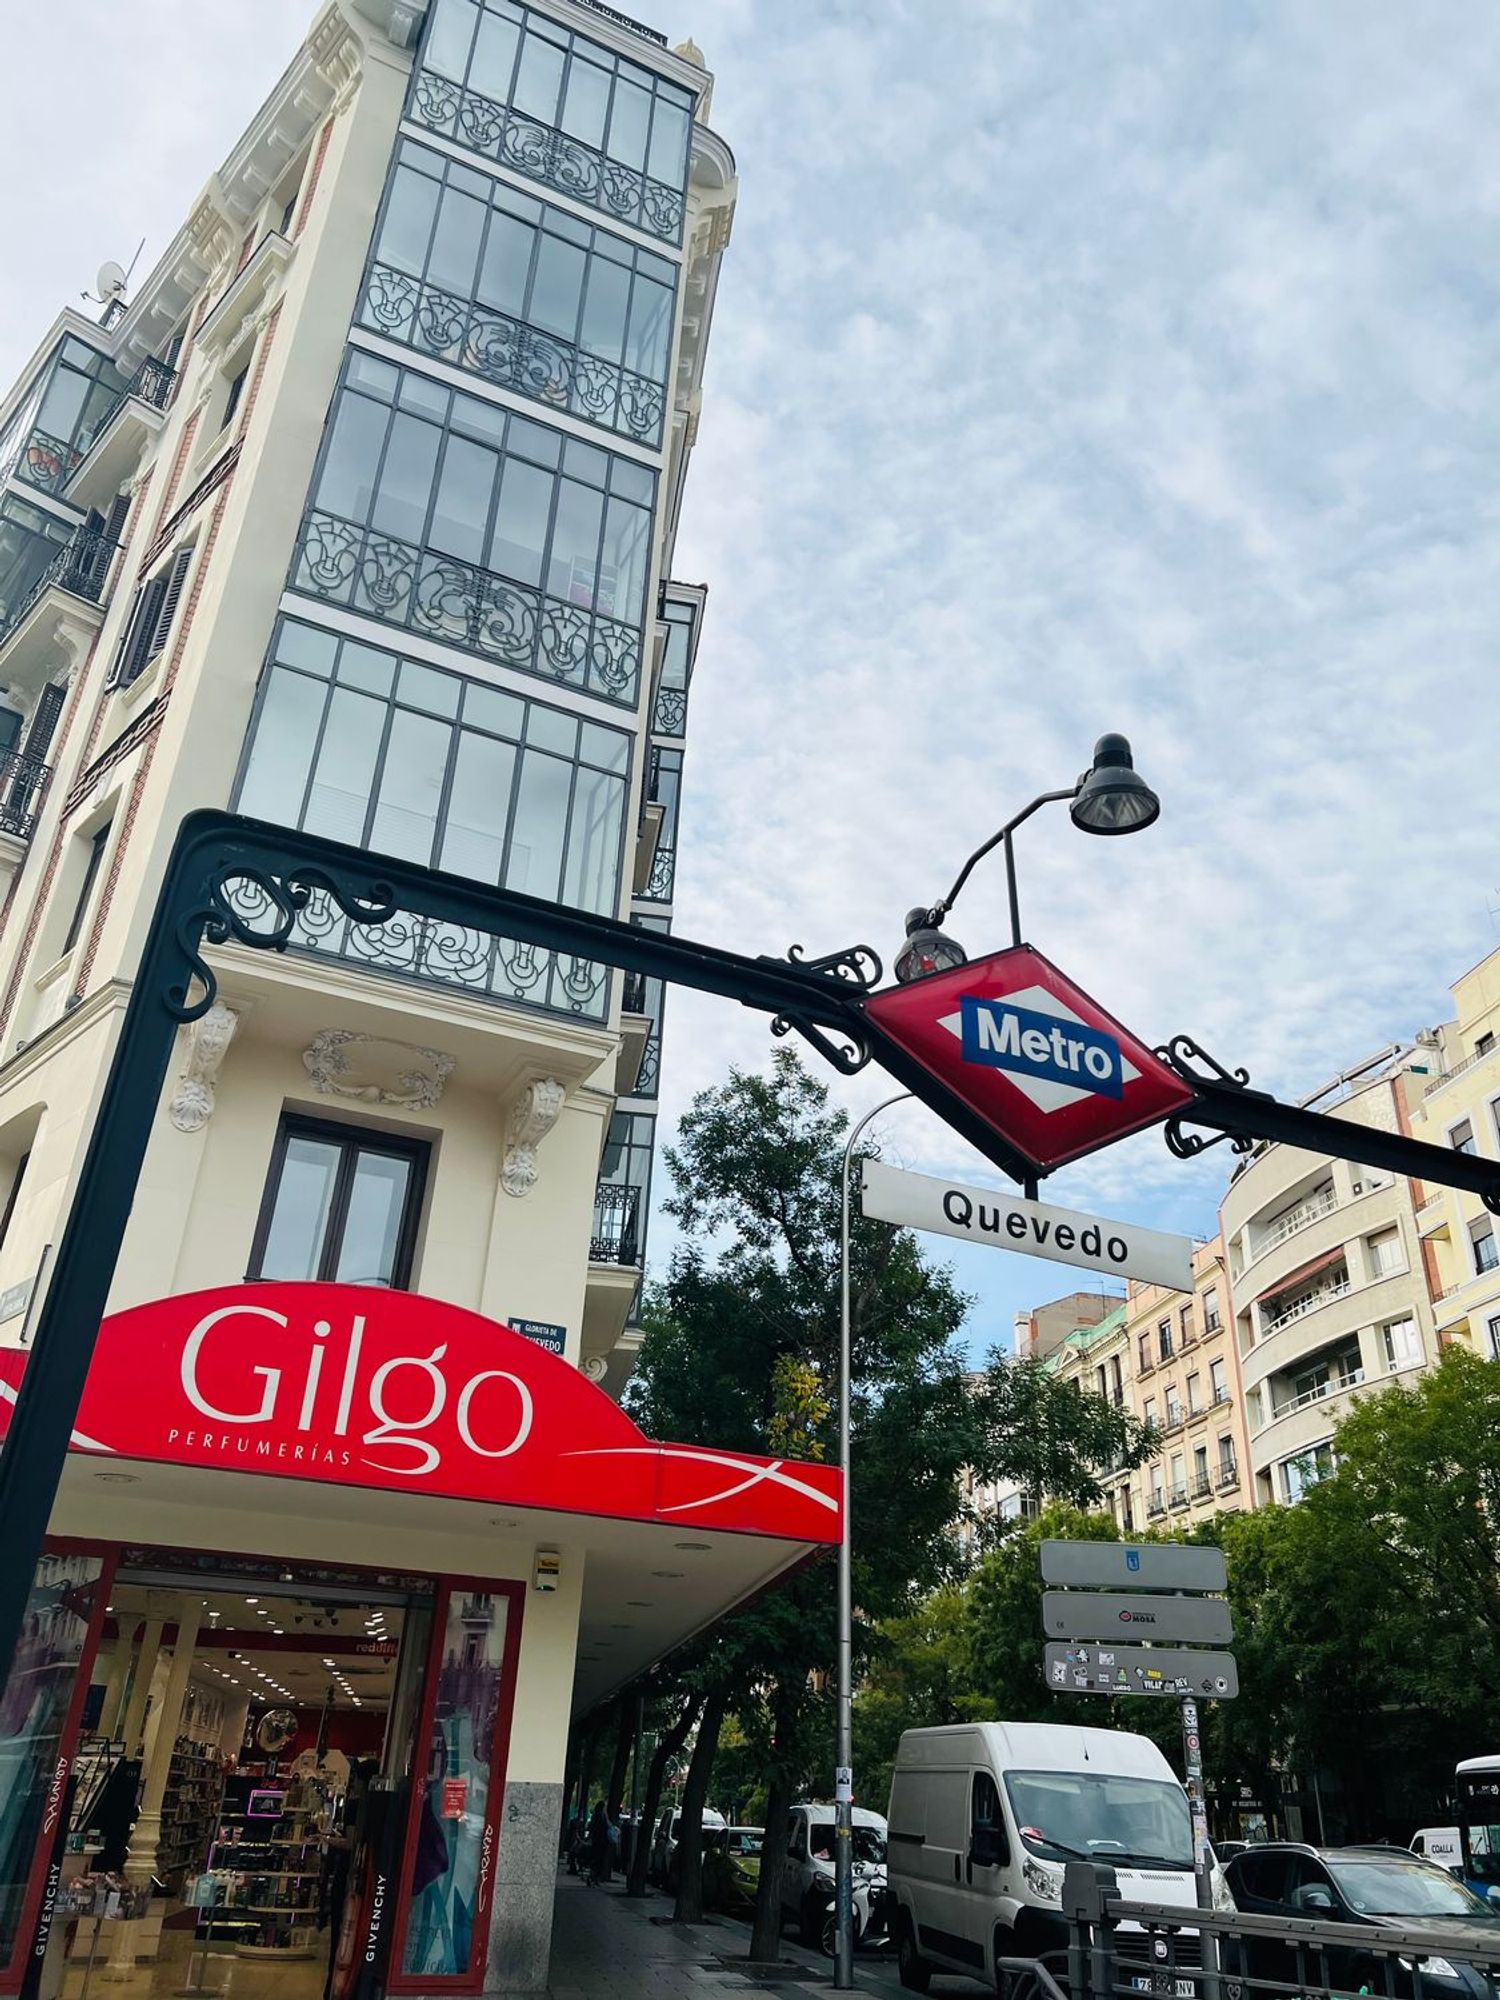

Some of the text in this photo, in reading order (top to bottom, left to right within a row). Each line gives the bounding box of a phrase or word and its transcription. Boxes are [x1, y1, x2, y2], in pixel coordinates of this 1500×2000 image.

[976, 1007, 1113, 1080] Metro
[943, 1190, 1128, 1263] Quevedo
[524, 1323, 558, 1336] GLORIETA DE
[526, 1336, 561, 1352] EVEDO
[180, 1305, 533, 1475] Gilgo
[168, 1429, 350, 1466] PERFUMERÍAS
[1431, 1844, 1454, 1854] COALLA
[35, 1863, 61, 1956] GIVENCHY
[366, 1874, 387, 1962] GIVENCHY
